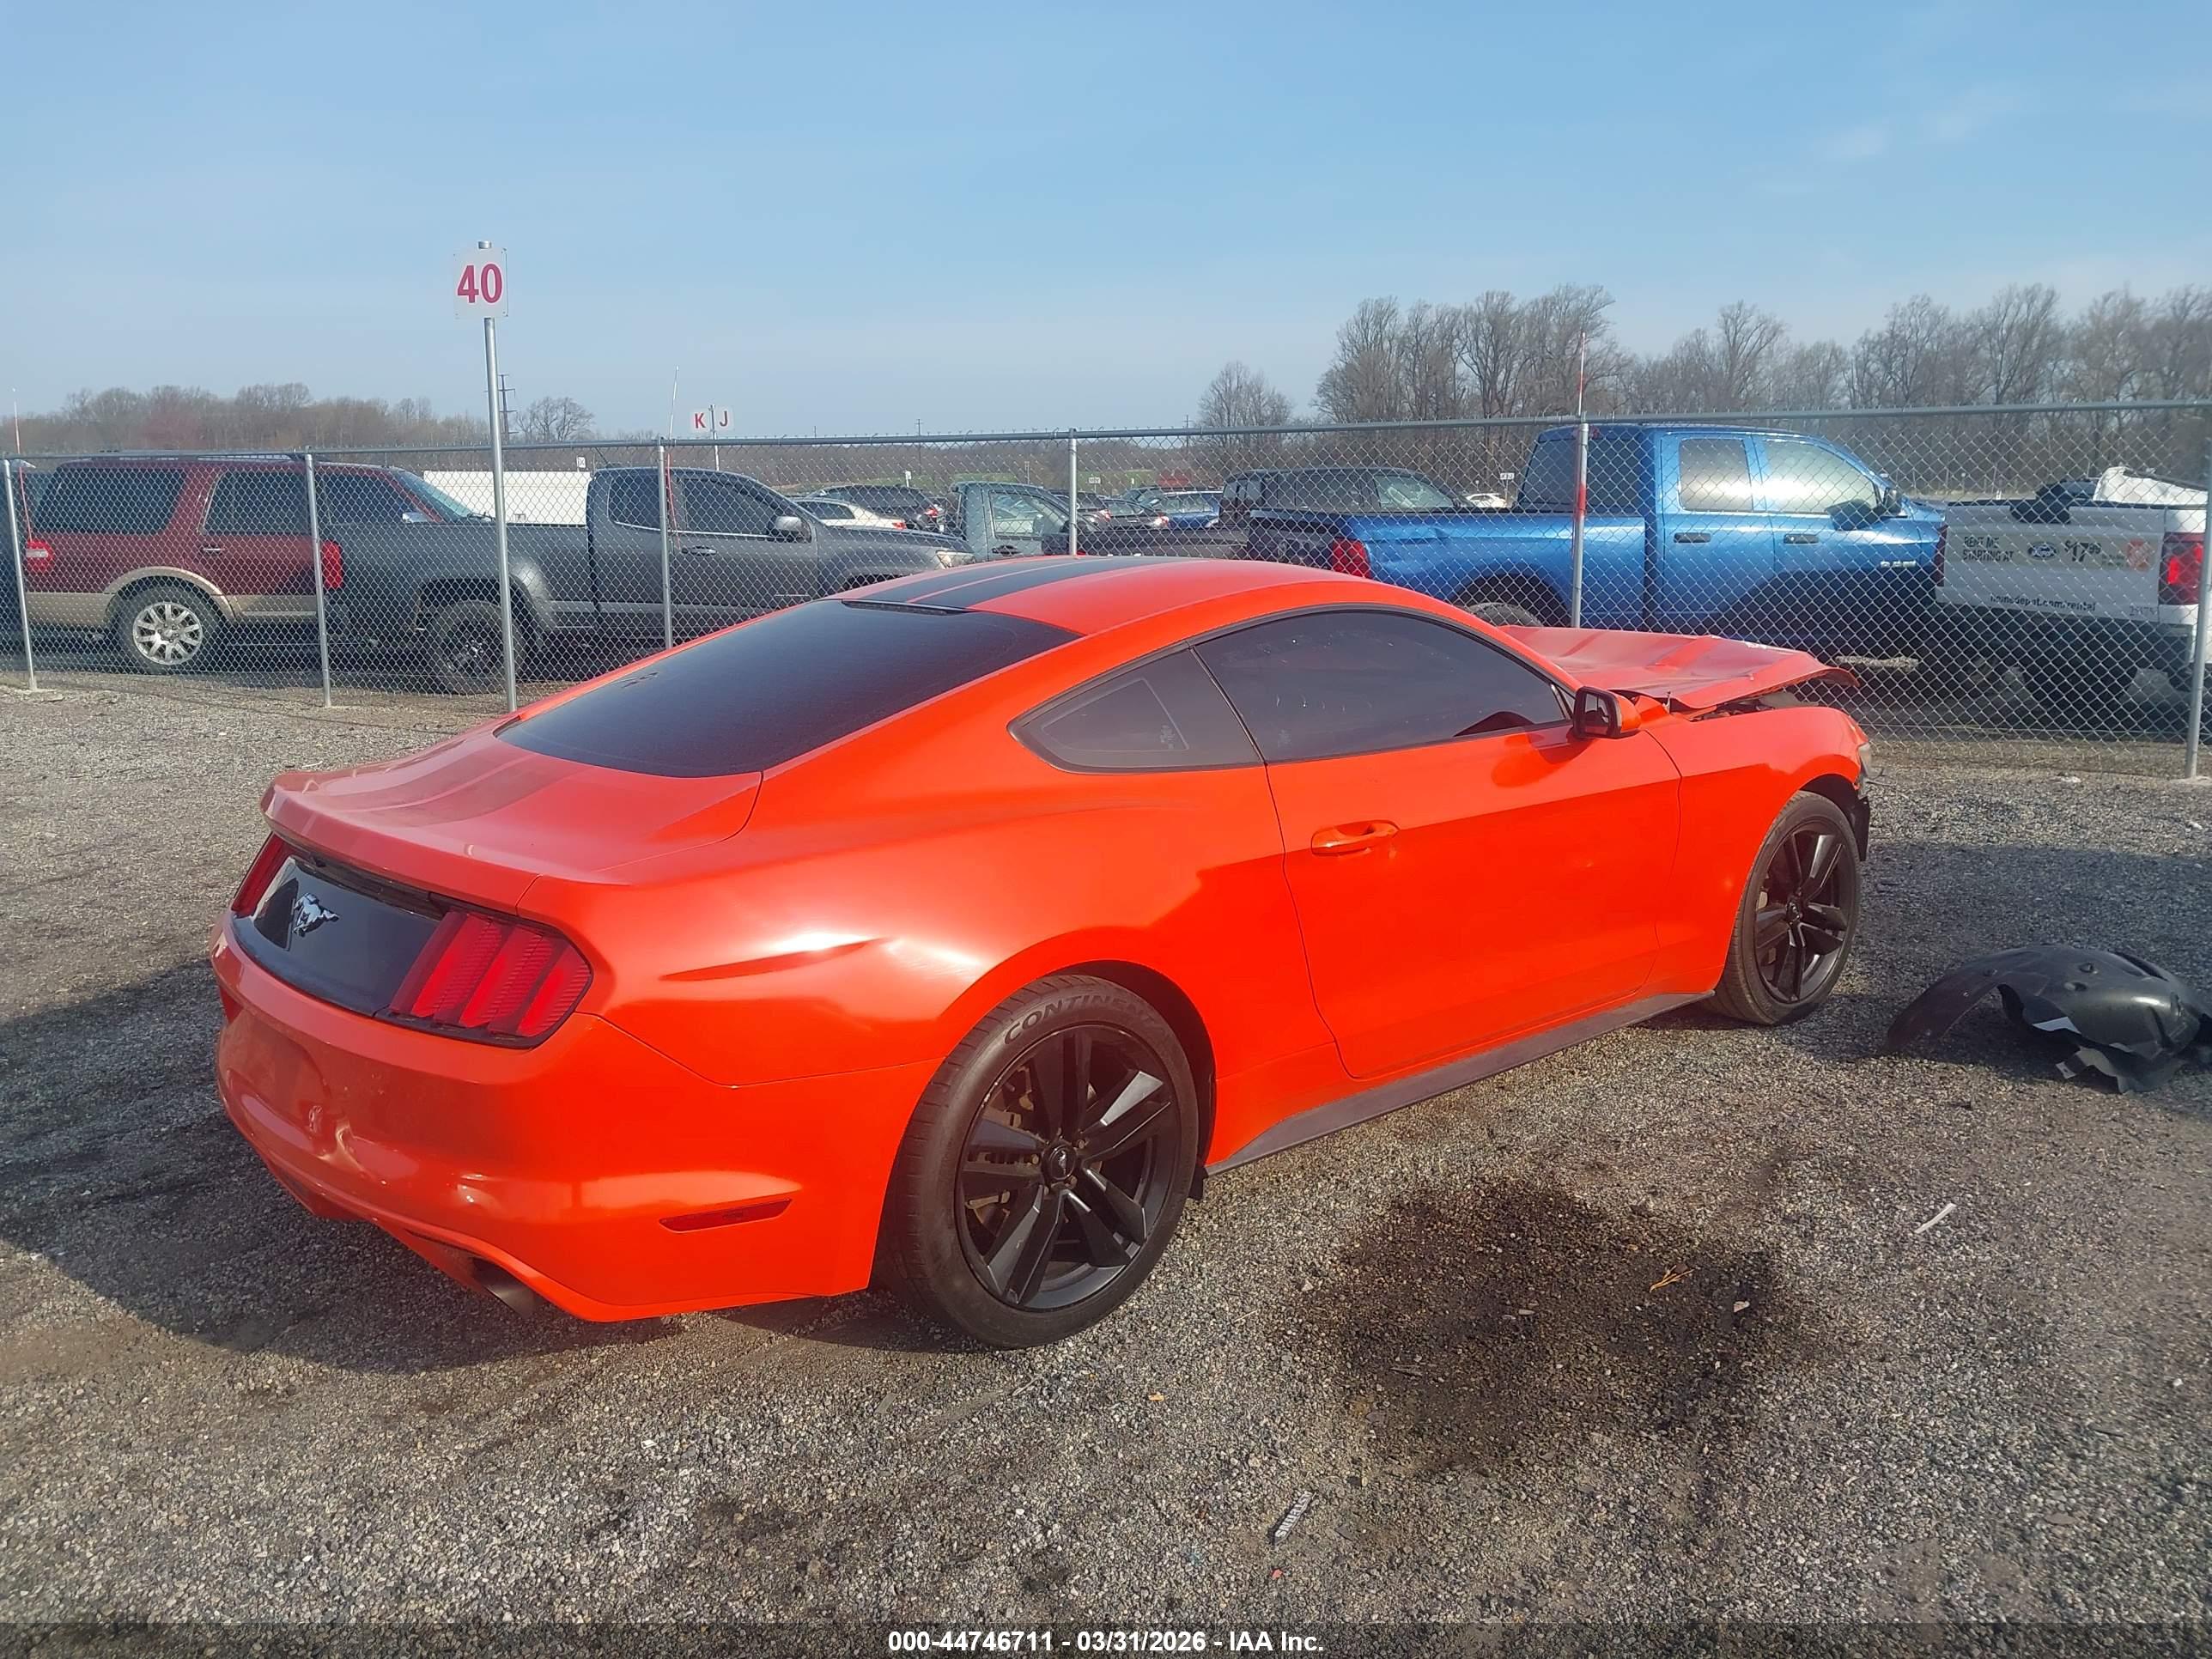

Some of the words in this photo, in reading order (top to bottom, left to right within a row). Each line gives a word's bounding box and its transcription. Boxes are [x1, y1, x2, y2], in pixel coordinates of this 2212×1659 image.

[457, 263, 503, 304] 40
[695, 412, 707, 429] K
[719, 410, 728, 428] J
[1004, 994, 1166, 1045] CONTINENT
